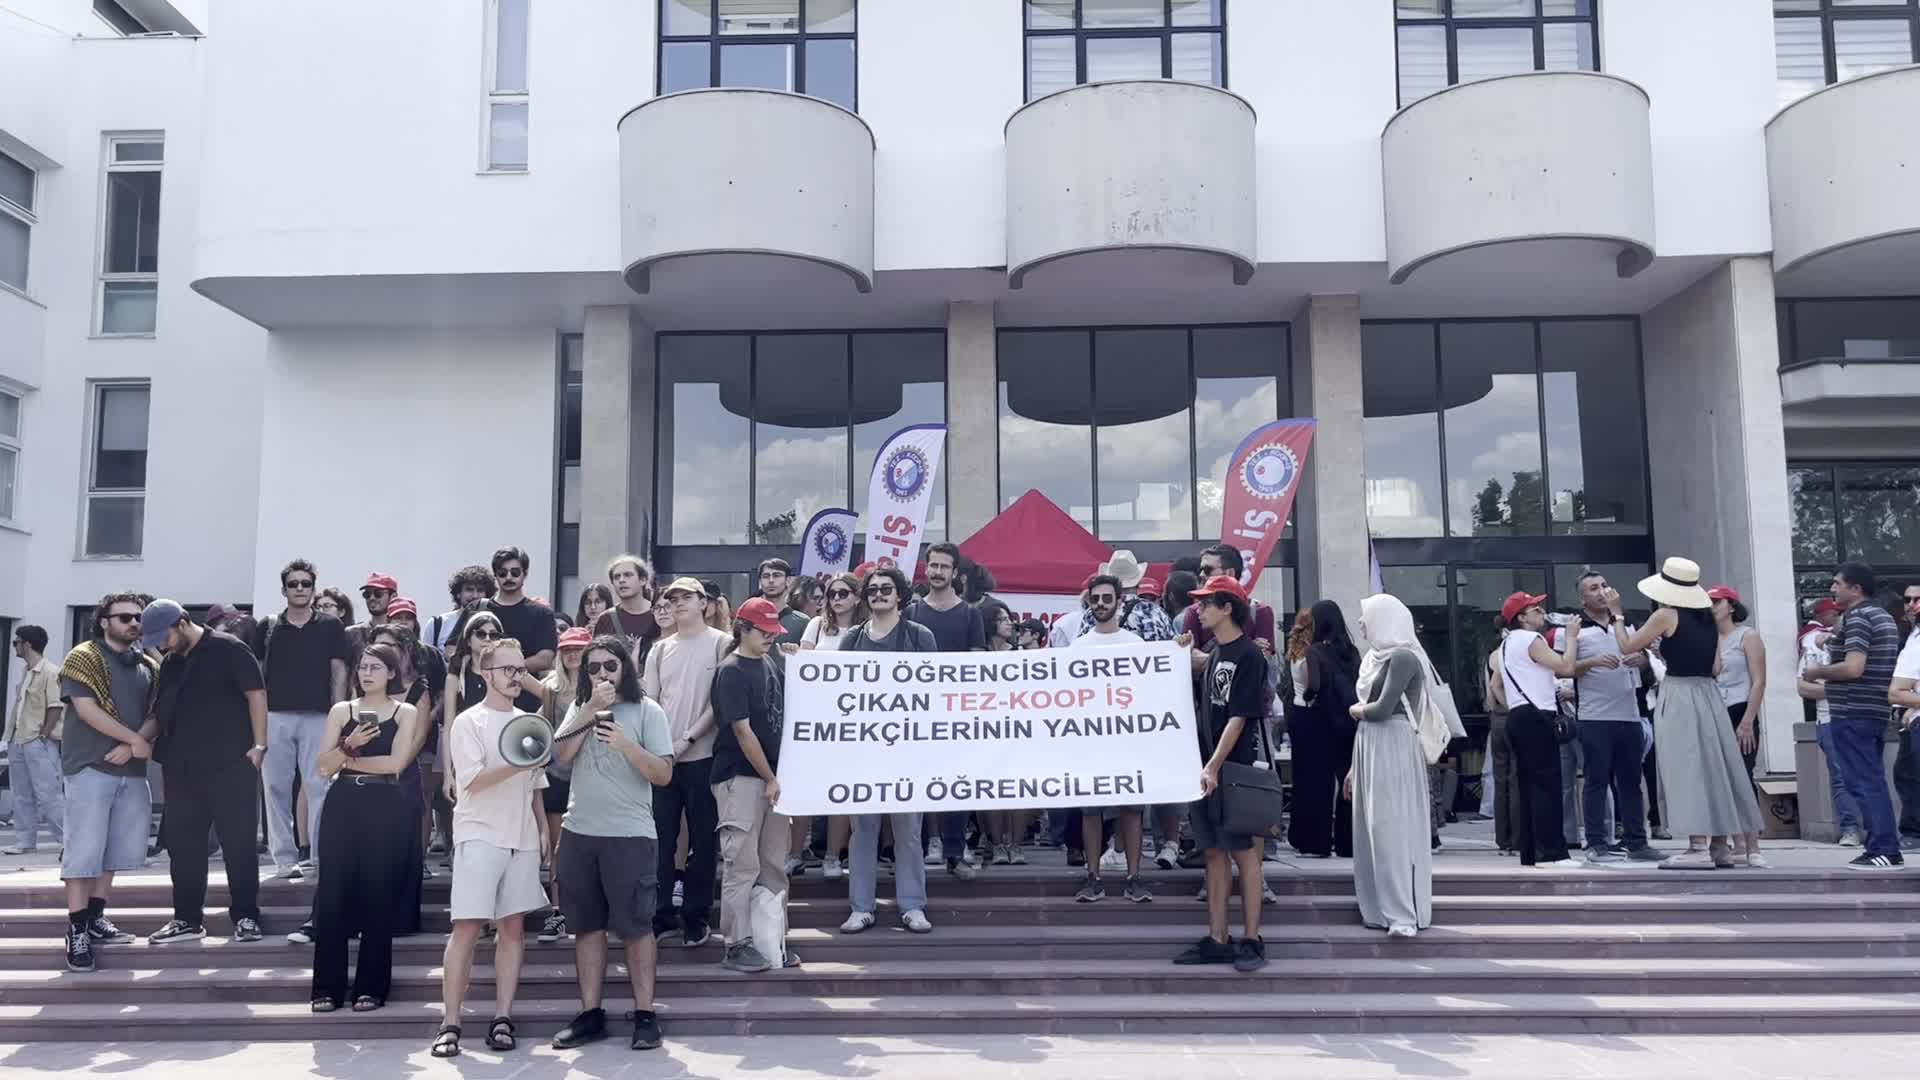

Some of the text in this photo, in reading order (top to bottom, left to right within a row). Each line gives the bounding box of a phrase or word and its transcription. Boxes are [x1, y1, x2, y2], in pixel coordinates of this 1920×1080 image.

[797, 655, 1172, 683] ODTÜ ÖĞRENCİSİ GREVE
[836, 683, 1133, 717] ÇIKAN TEZ-KOOP İŞ
[792, 711, 1182, 745] EMEKÇİLERİNİN YANINDA
[827, 769, 1144, 804] ODTÜ ÖĞRENCİLERİ
